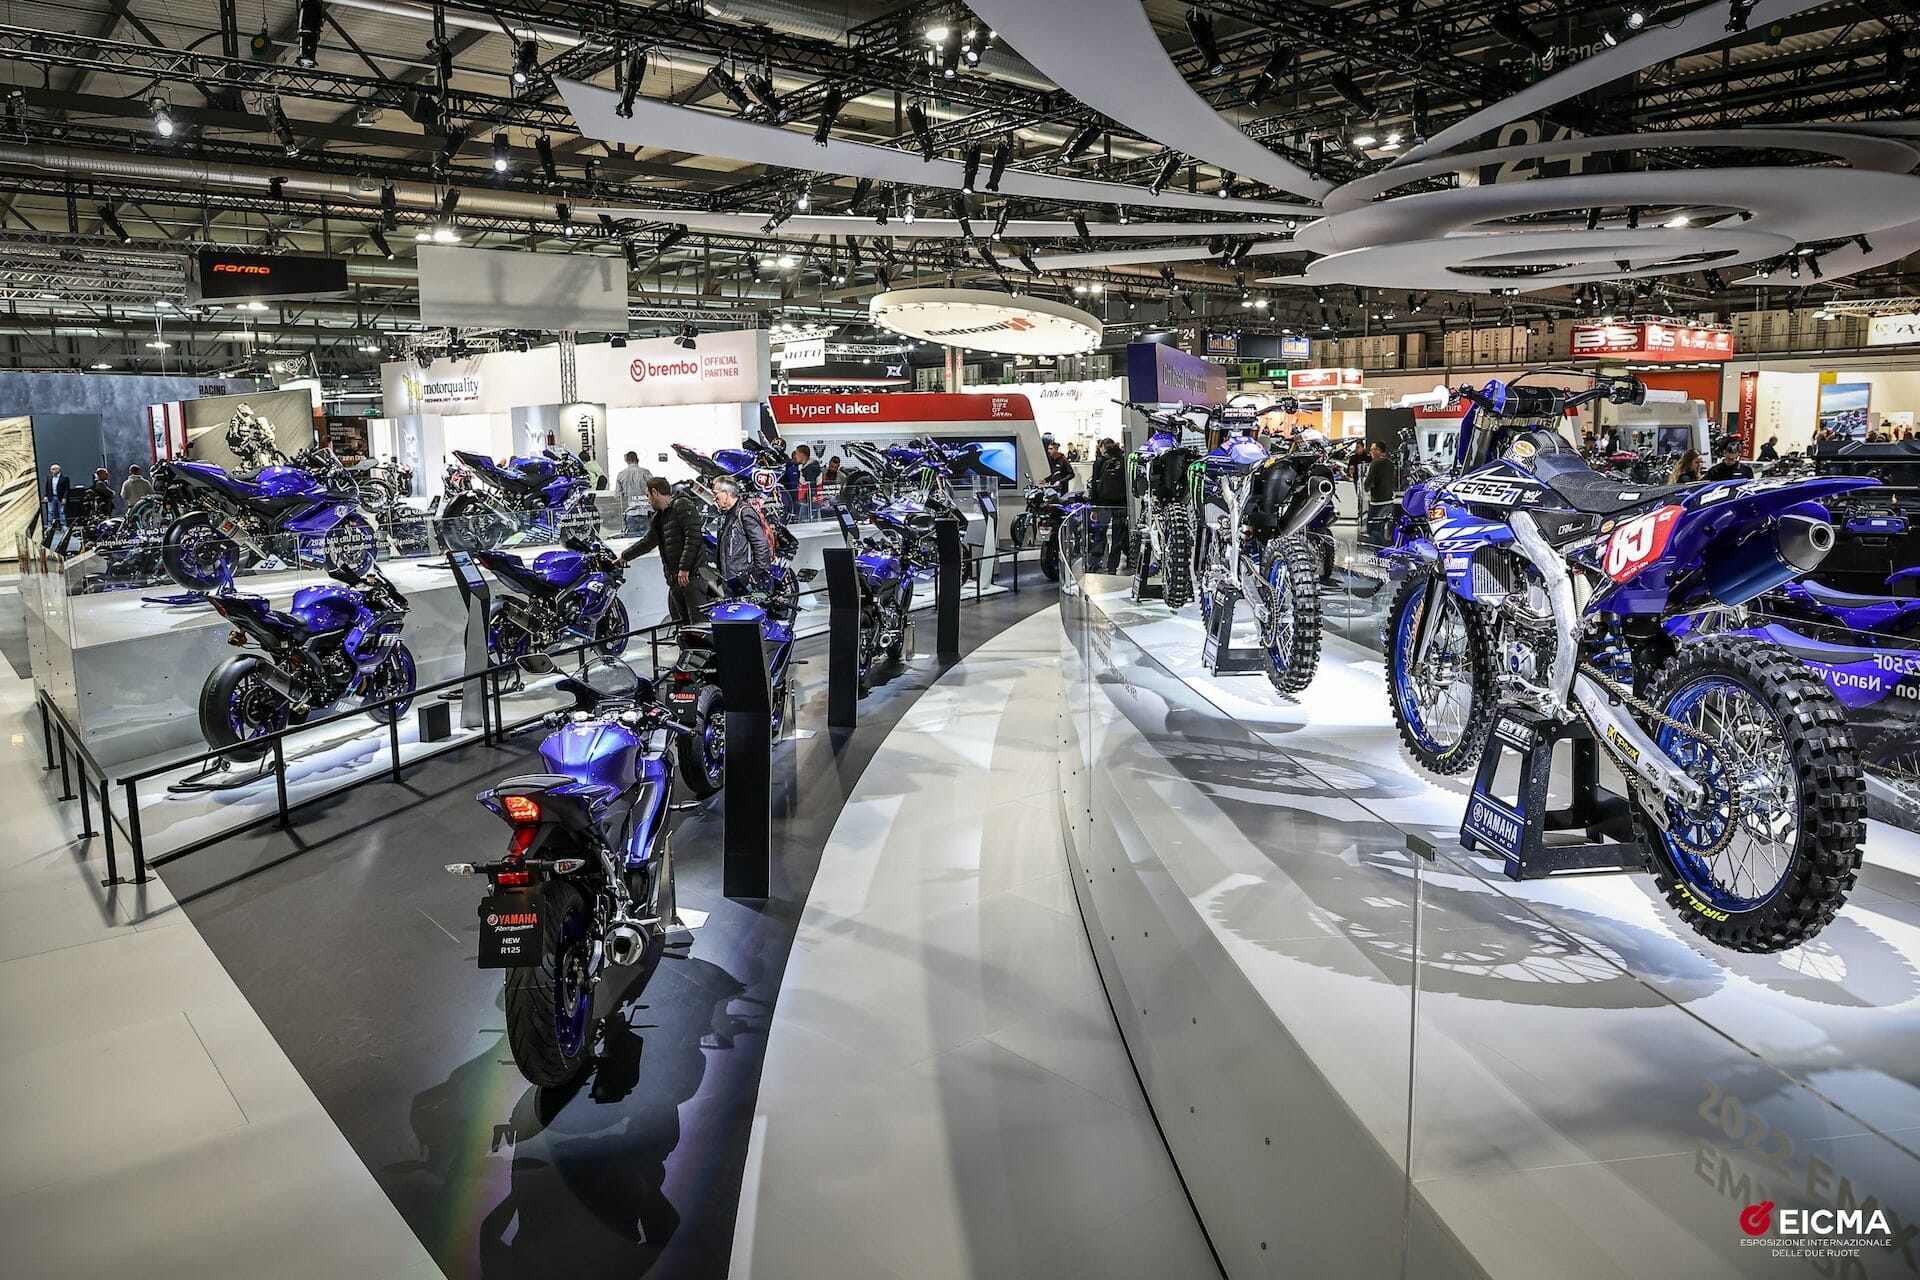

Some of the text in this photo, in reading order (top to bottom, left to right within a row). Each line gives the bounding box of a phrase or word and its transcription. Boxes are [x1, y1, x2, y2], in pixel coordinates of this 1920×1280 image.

[1183, 328, 1196, 340] 24
[1575, 329, 1638, 348] BS
[1648, 329, 1675, 347] BS
[648, 360, 698, 378] brembo
[704, 355, 739, 366] OFFICIAL
[704, 367, 739, 378] PARTNER
[199, 384, 226, 396] RACING
[423, 377, 480, 398] motorquality
[789, 401, 880, 418] Hyper Naked
[1422, 403, 1463, 414] Adventure
[577, 413, 591, 452] quality
[1453, 482, 1507, 498] CERES
[1500, 490, 1519, 503] 71
[1499, 717, 1533, 742] GYTR
[1483, 807, 1518, 844] YAMAHA
[1474, 822, 1513, 849] RACING
[1674, 883, 1730, 923] PIRELLI
[498, 913, 538, 925] YAMAHA
[500, 946, 521, 954] R125
[1698, 1080, 1793, 1181] 2022
